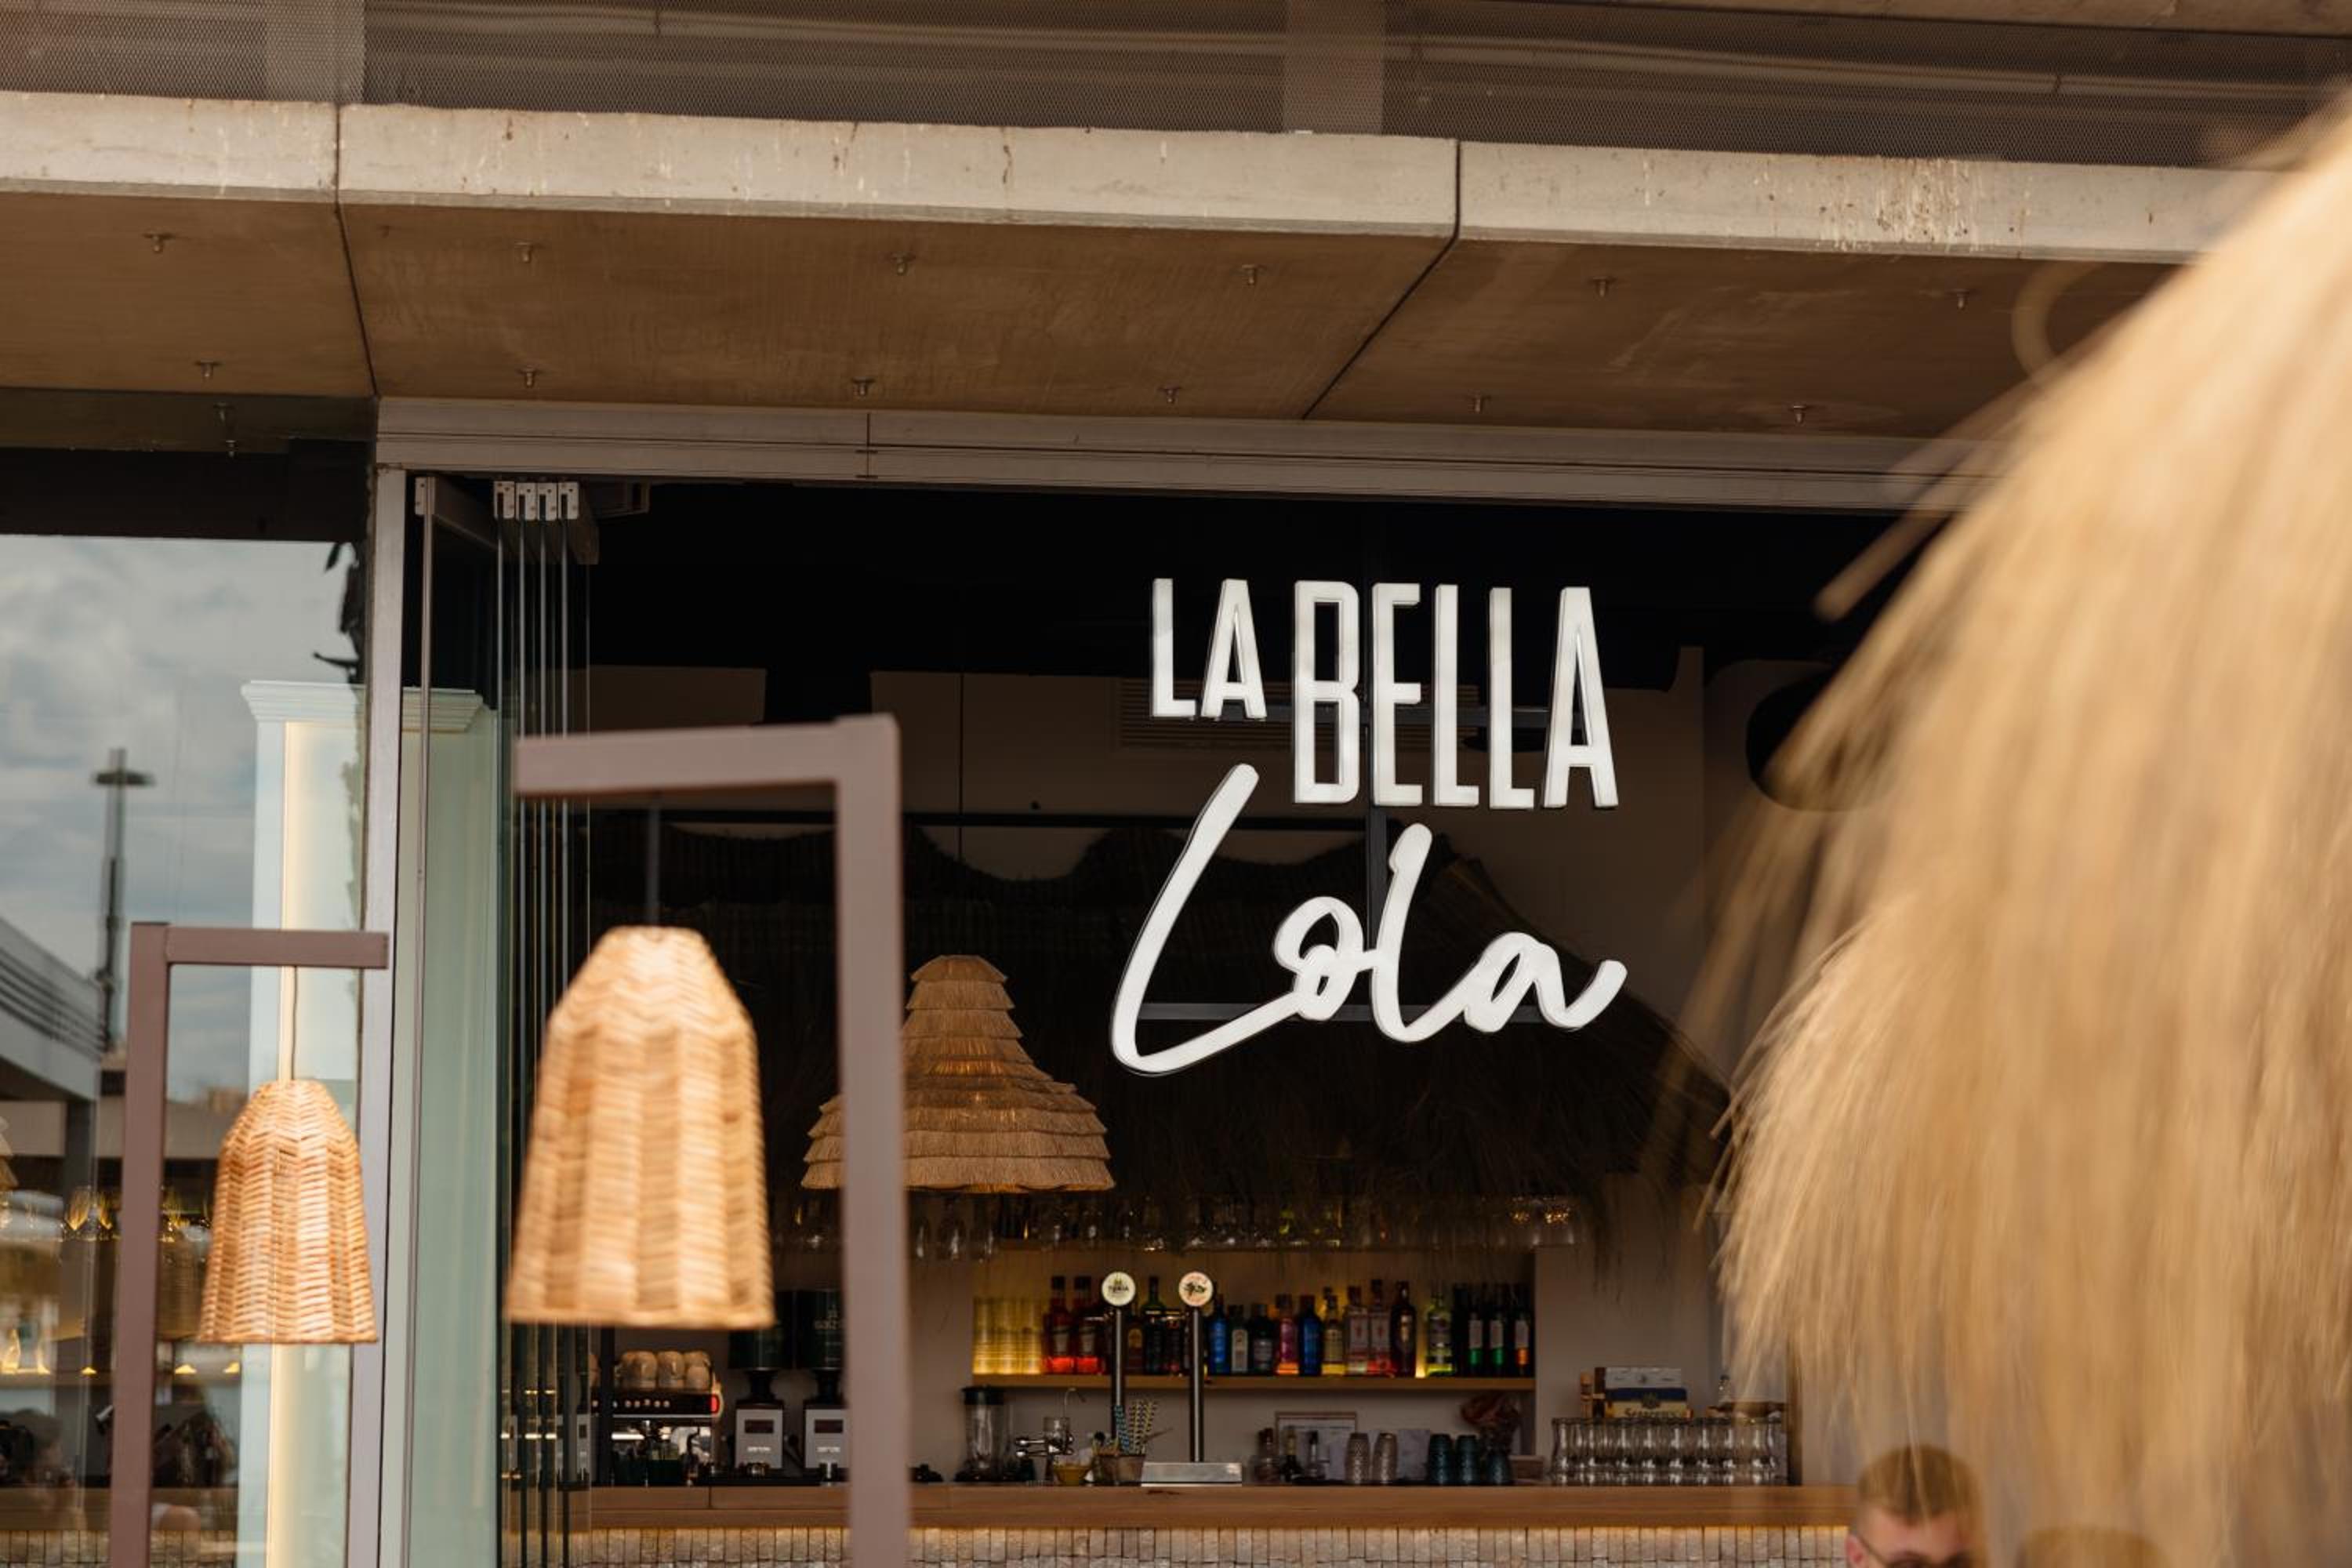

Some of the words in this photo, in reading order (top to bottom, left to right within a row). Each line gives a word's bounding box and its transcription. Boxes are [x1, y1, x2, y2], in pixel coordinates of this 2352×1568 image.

[1151, 579, 1267, 719] LA
[1294, 580, 1618, 809] BELLA
[1110, 764, 1628, 1076] Lola
